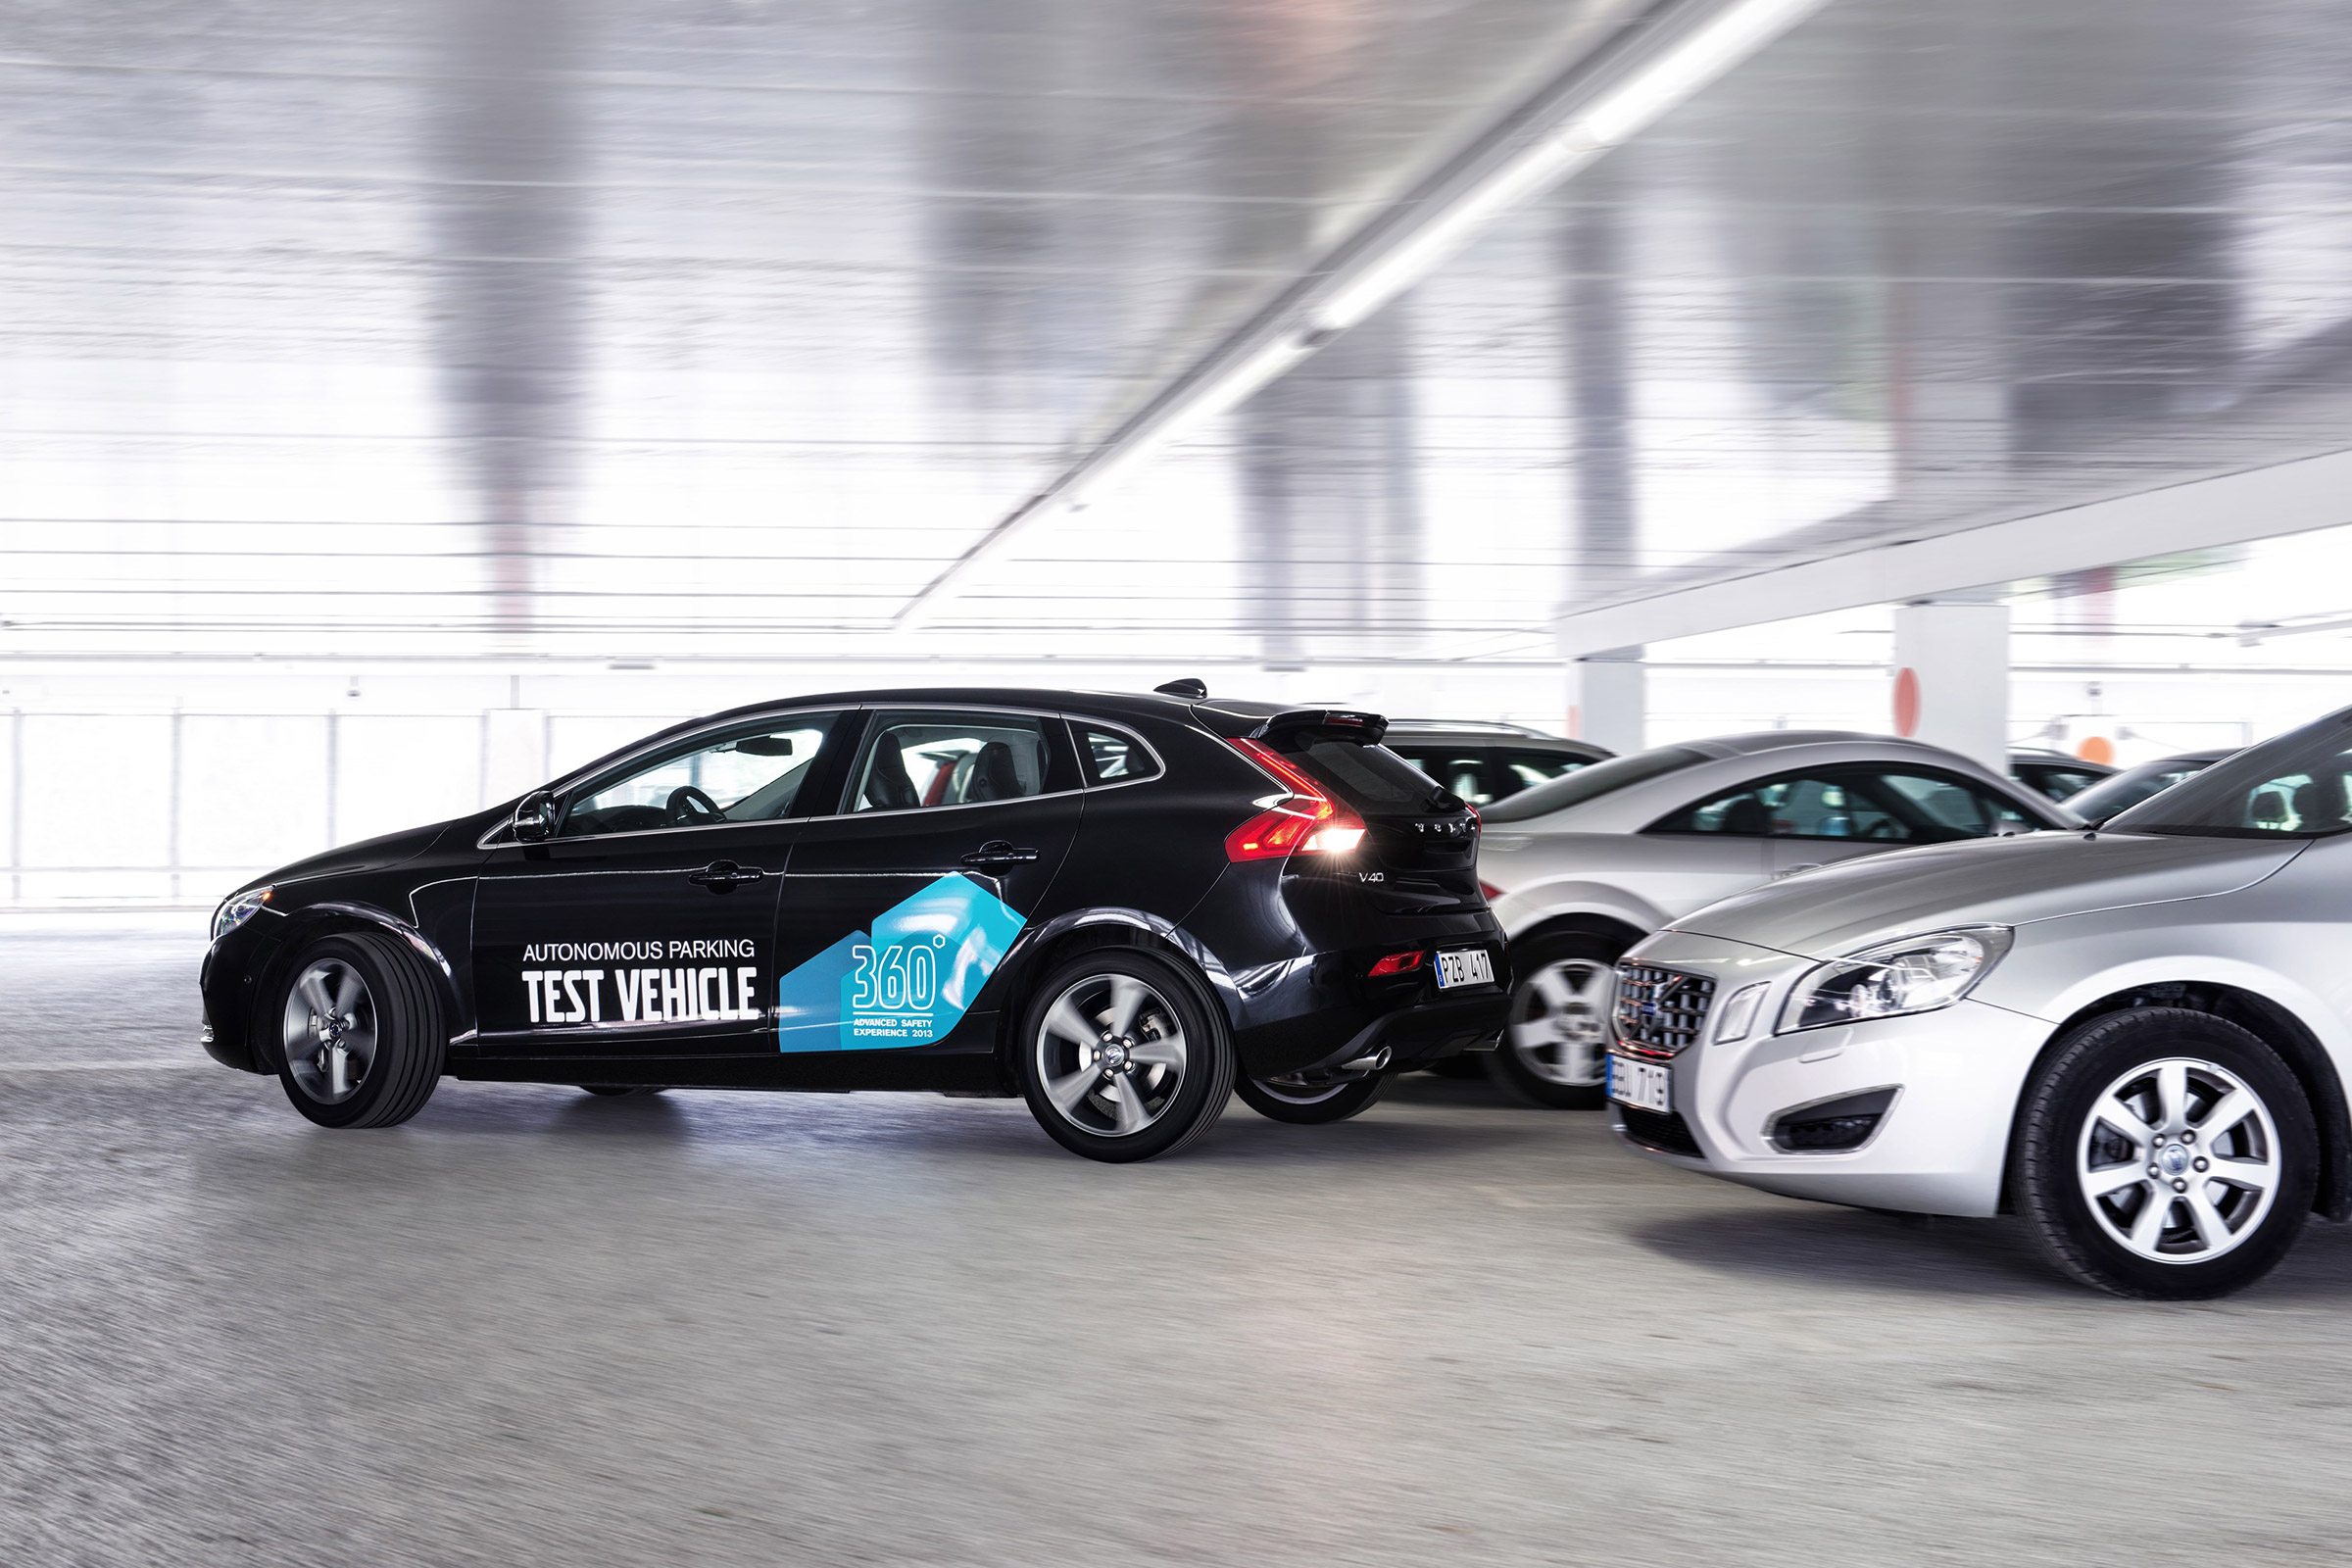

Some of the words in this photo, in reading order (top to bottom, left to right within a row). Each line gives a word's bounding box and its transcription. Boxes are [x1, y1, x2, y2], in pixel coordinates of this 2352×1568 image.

[1358, 871, 1385, 883] V40
[522, 941, 663, 961] AUTONOMOUS
[668, 939, 756, 959] PARKING
[1441, 955, 1465, 984] PZB
[1469, 953, 1489, 981] 417
[521, 969, 605, 1023] TEST
[614, 966, 760, 1021] VEHICLE
[853, 1018, 898, 1028] ADVANCED
[901, 1018, 933, 1028] SAFETY
[853, 1028, 908, 1038] EXPERIENCE
[911, 1028, 933, 1038] 2013
